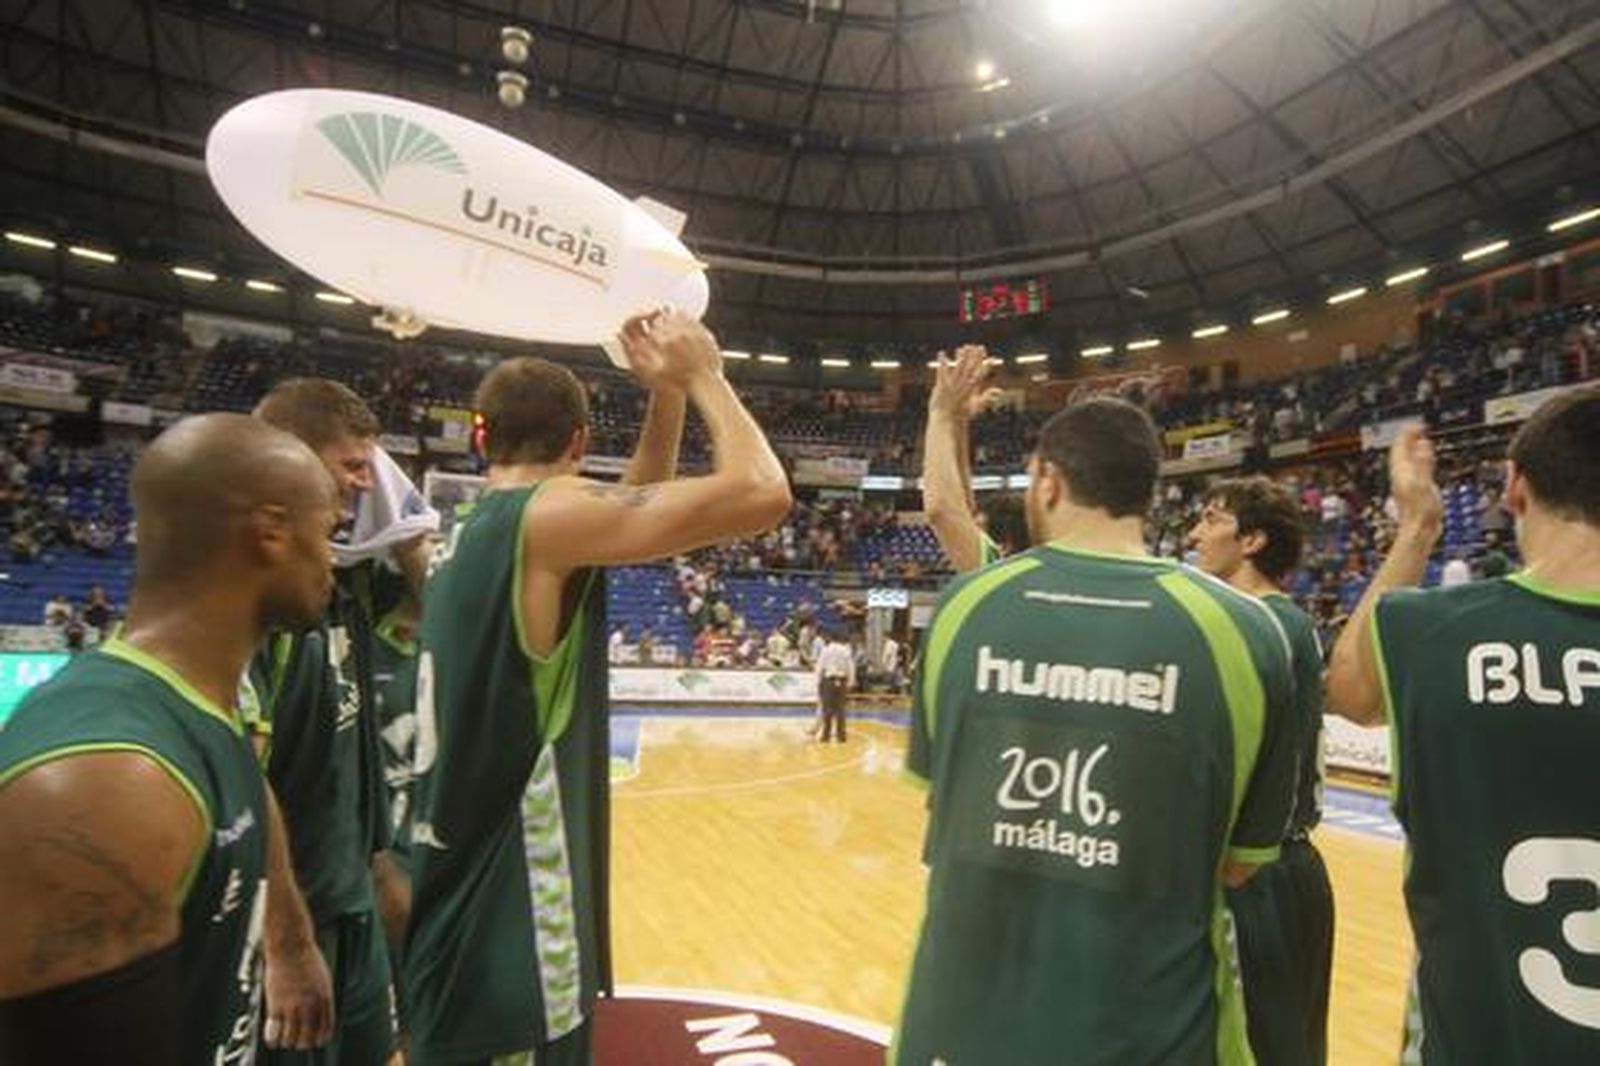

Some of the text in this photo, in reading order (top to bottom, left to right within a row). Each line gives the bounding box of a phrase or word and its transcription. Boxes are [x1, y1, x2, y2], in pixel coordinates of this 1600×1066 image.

[462, 188, 609, 267] Unicaja
[976, 645, 1179, 714] hummel
[993, 819, 1119, 868] málaga
